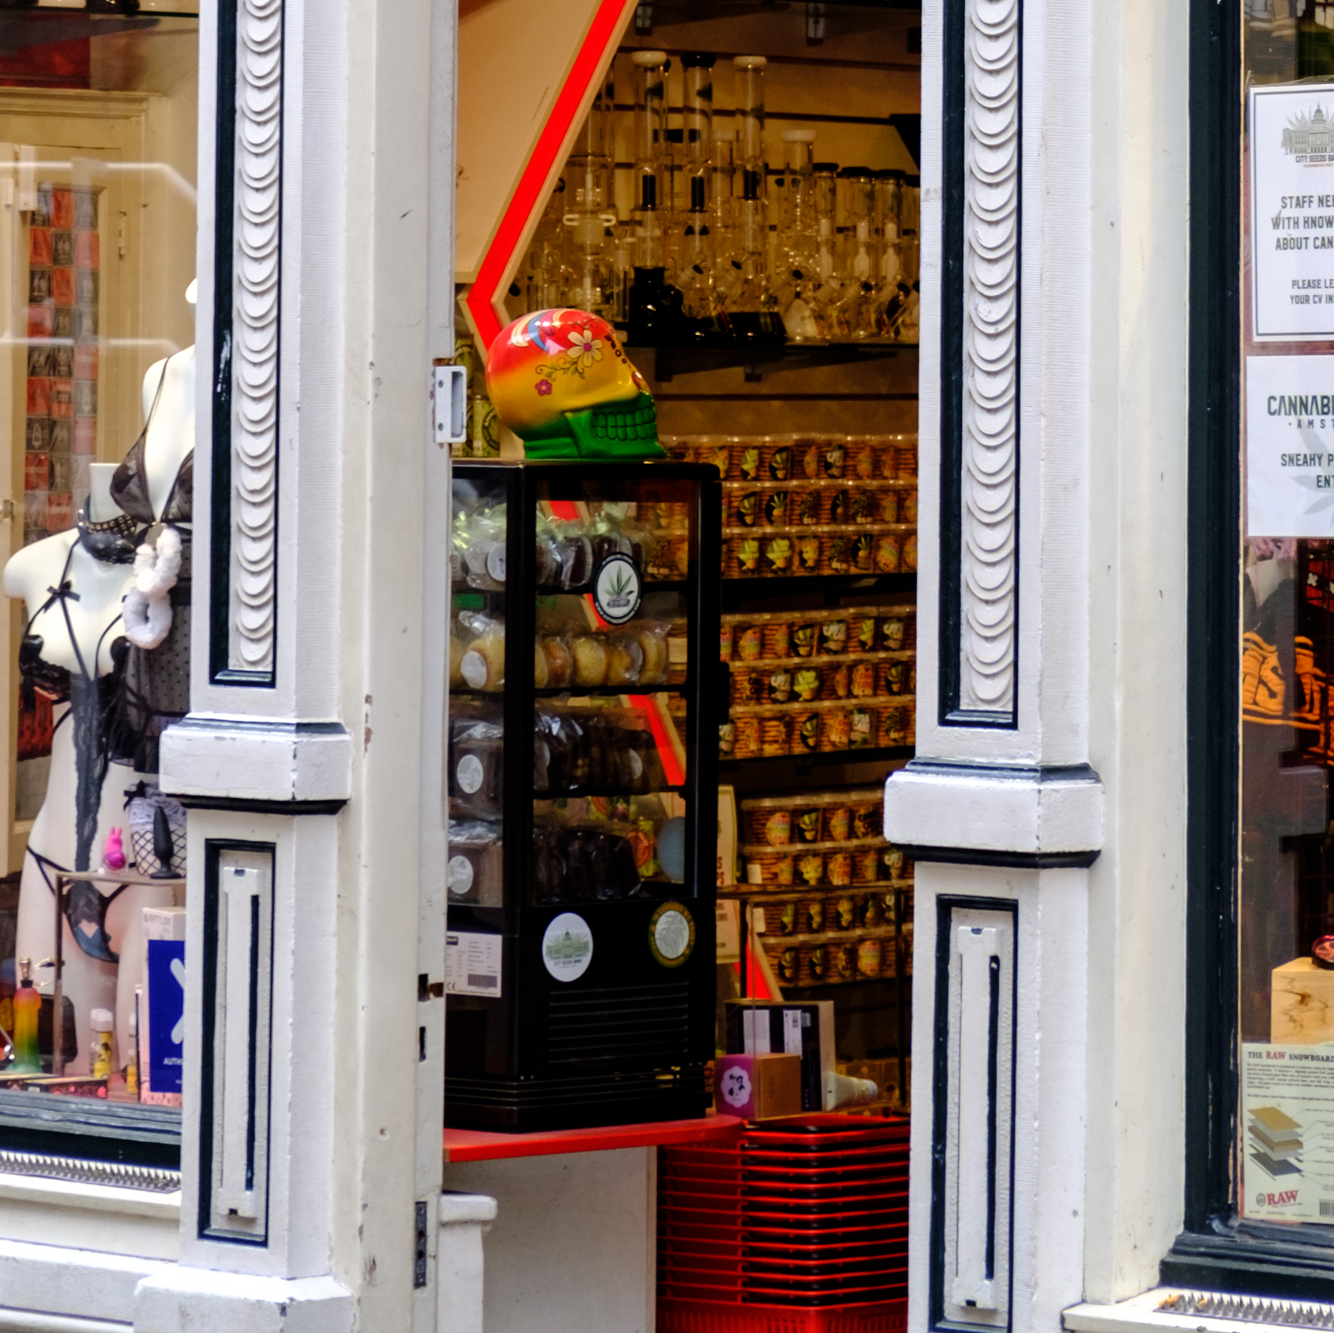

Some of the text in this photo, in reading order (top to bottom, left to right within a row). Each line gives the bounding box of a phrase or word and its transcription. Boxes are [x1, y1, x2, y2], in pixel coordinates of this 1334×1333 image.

[1295, 155, 1308, 164] CITY
[1309, 154, 1327, 163] SEEDS
[1280, 195, 1315, 210] STAFF
[1271, 216, 1300, 231] WITH
[1275, 236, 1310, 251] ABOUT
[1291, 279, 1322, 290] PLEASE
[1290, 294, 1310, 305] YOUR
[1312, 294, 1323, 304] CV
[1280, 453, 1324, 467] SNEAKY
[1248, 1051, 1263, 1059] THE
[1265, 1050, 1287, 1060] RAW
[1267, 1189, 1300, 1206] RAW
